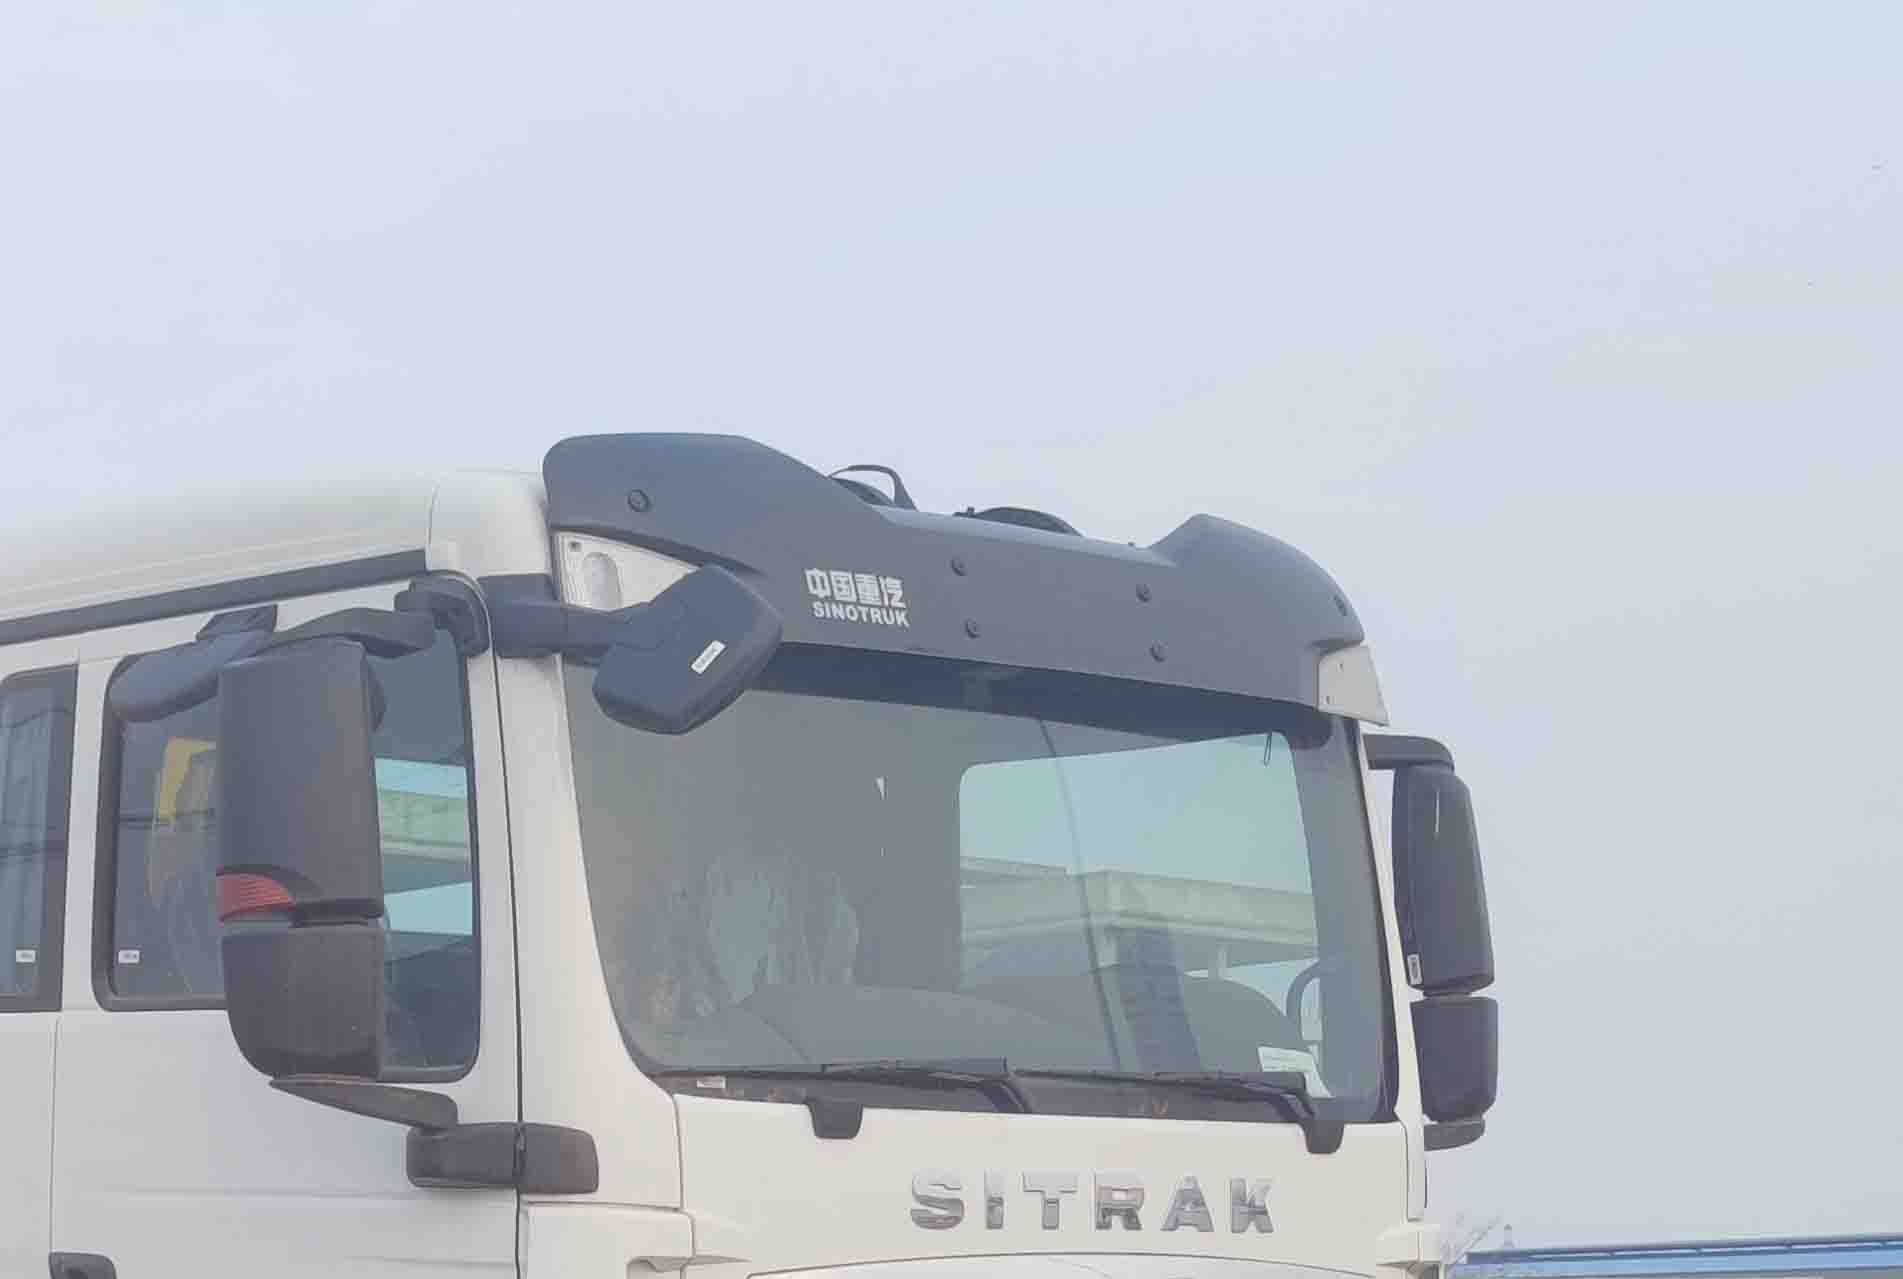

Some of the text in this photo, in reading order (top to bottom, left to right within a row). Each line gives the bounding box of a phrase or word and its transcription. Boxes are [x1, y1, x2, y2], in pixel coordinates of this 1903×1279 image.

[805, 568, 906, 608] 中国重汽
[813, 602, 910, 627] SINOTRUK
[910, 1168, 1274, 1233] SITRAK
